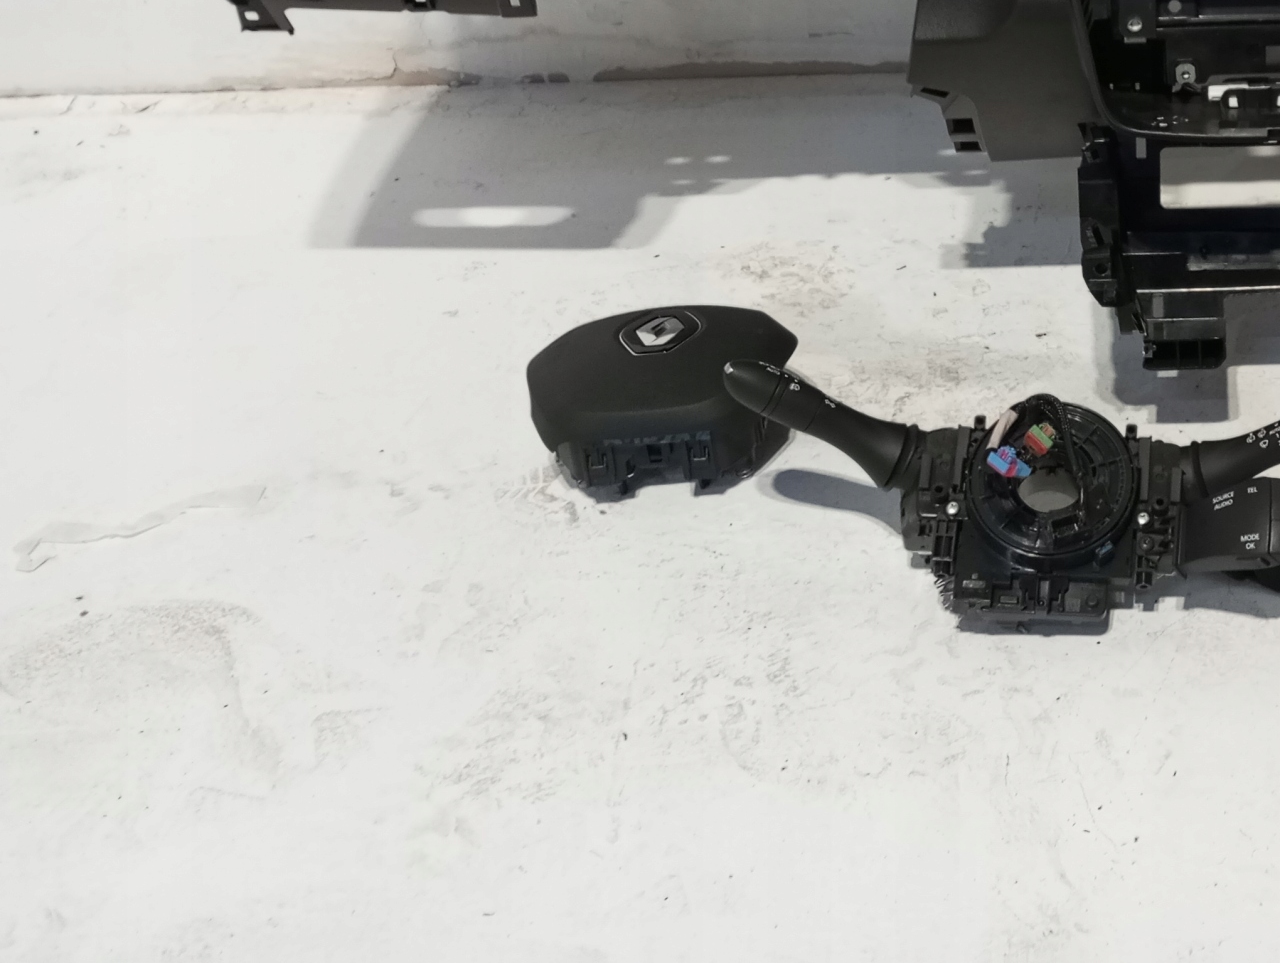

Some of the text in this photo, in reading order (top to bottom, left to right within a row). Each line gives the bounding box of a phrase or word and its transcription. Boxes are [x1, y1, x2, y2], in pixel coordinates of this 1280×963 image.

[1212, 490, 1234, 504] SOURCE
[1213, 498, 1234, 511] AUDIO
[1240, 533, 1260, 542] MODE
[1245, 542, 1256, 550] OK
